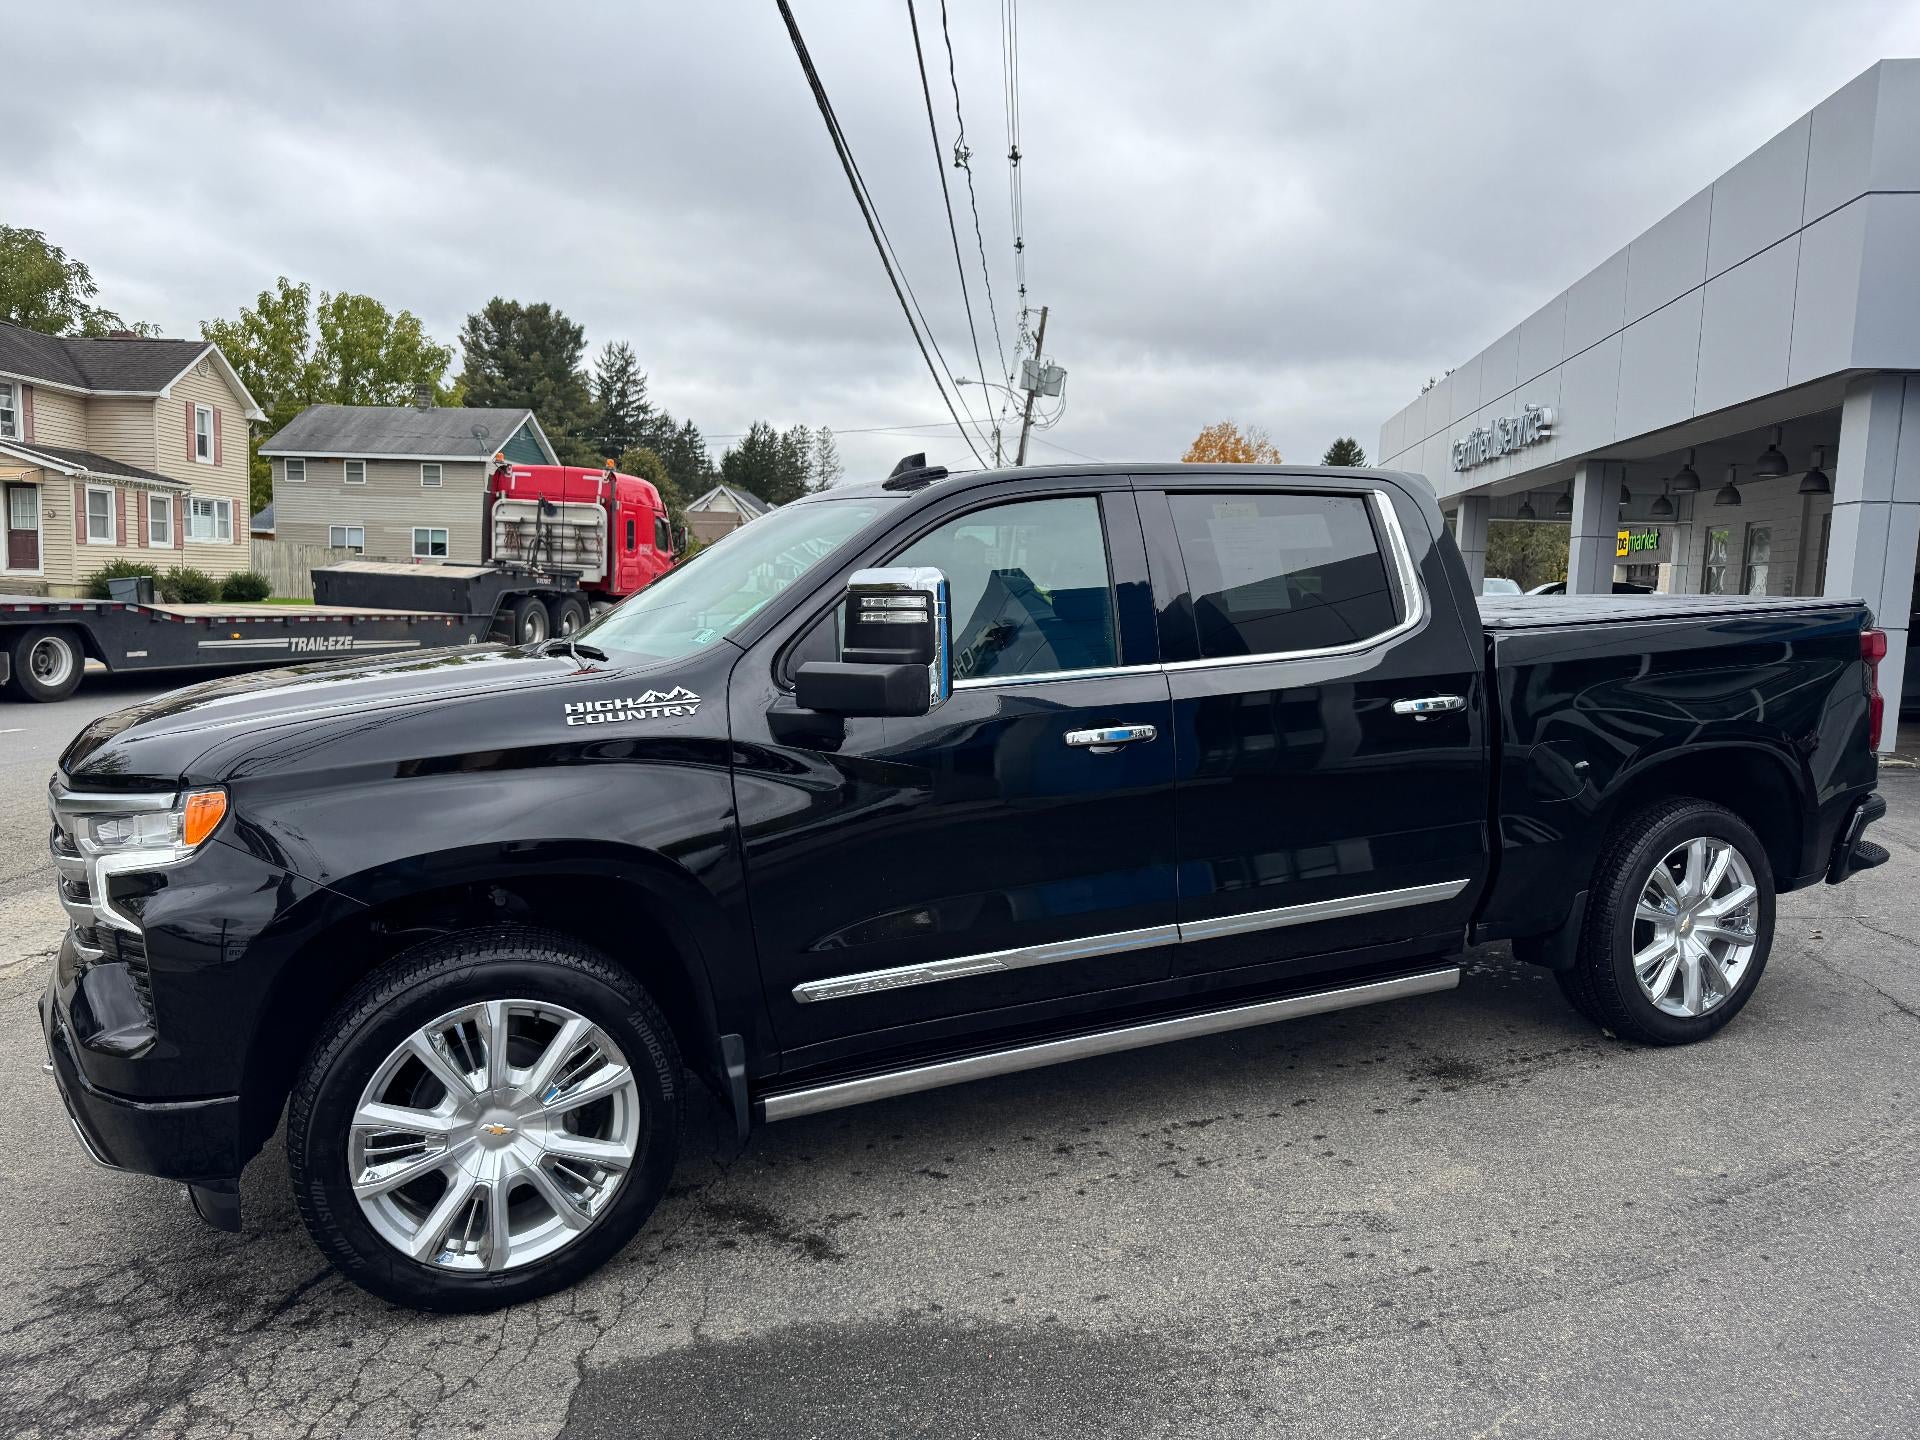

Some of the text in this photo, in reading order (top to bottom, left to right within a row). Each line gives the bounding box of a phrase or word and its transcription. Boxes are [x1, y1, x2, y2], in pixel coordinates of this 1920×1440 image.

[1452, 403, 1552, 472] Certified Service
[1618, 528, 1659, 552] DG market
[290, 636, 353, 652] TRAIL-EZE
[564, 697, 634, 715] HIGH
[566, 703, 701, 726] COUNTRY
[814, 973, 923, 999] SILVERADO
[626, 1010, 675, 1102] BRIDGESTONE
[310, 1177, 367, 1269] BRIDESTONE
